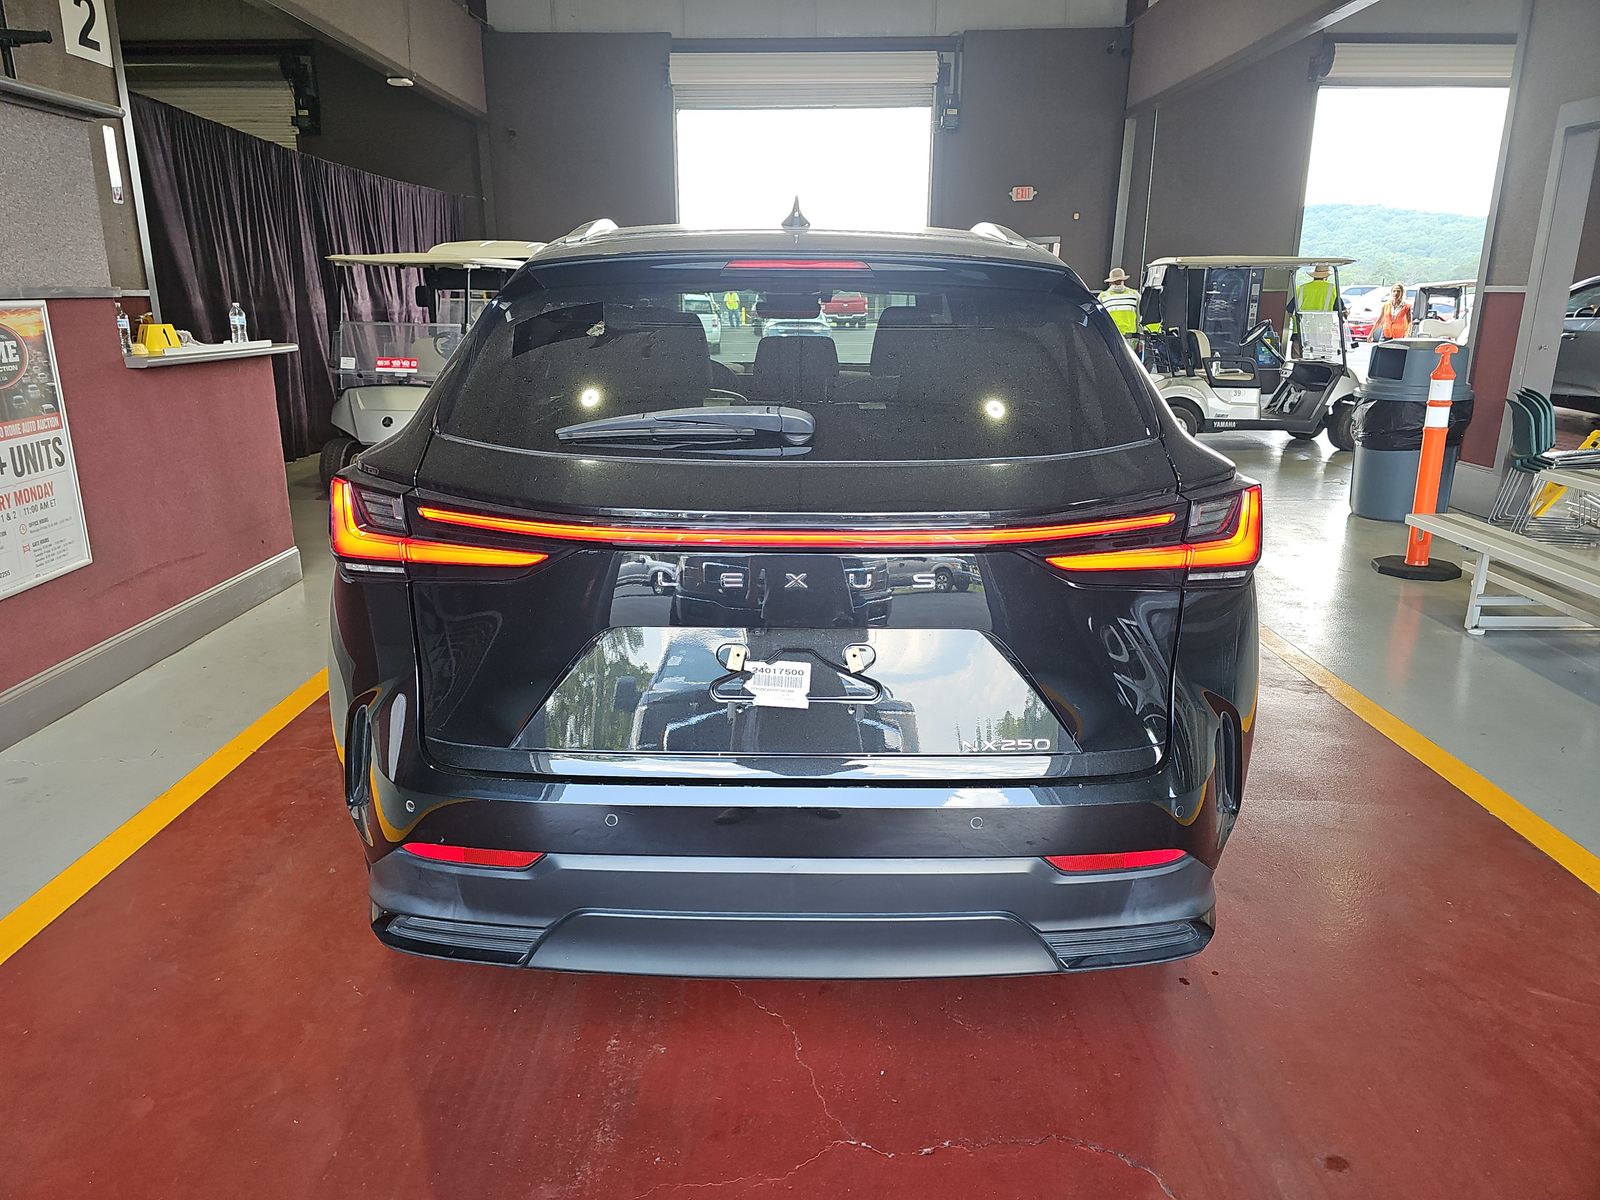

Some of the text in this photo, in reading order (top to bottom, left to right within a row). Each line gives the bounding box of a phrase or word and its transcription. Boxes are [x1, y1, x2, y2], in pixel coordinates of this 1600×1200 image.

[73, 0, 101, 52] 2
[1016, 188, 1031, 200] EXIT
[162, 327, 172, 347] 1
[1233, 389, 1242, 397] 39
[4, 424, 22, 437] ROME
[22, 420, 37, 433] AUTO
[37, 416, 60, 431] AUCTION
[9, 436, 66, 478] UNITS
[14, 481, 54, 507] MONDAY
[6, 512, 11, 521] &
[12, 510, 17, 519] 2
[23, 503, 39, 516] 11:00
[40, 501, 49, 511] AM
[50, 498, 57, 508] ET
[657, 572, 937, 589] LEXUS
[751, 666, 805, 676] 24017500
[961, 739, 1051, 752] NX250
